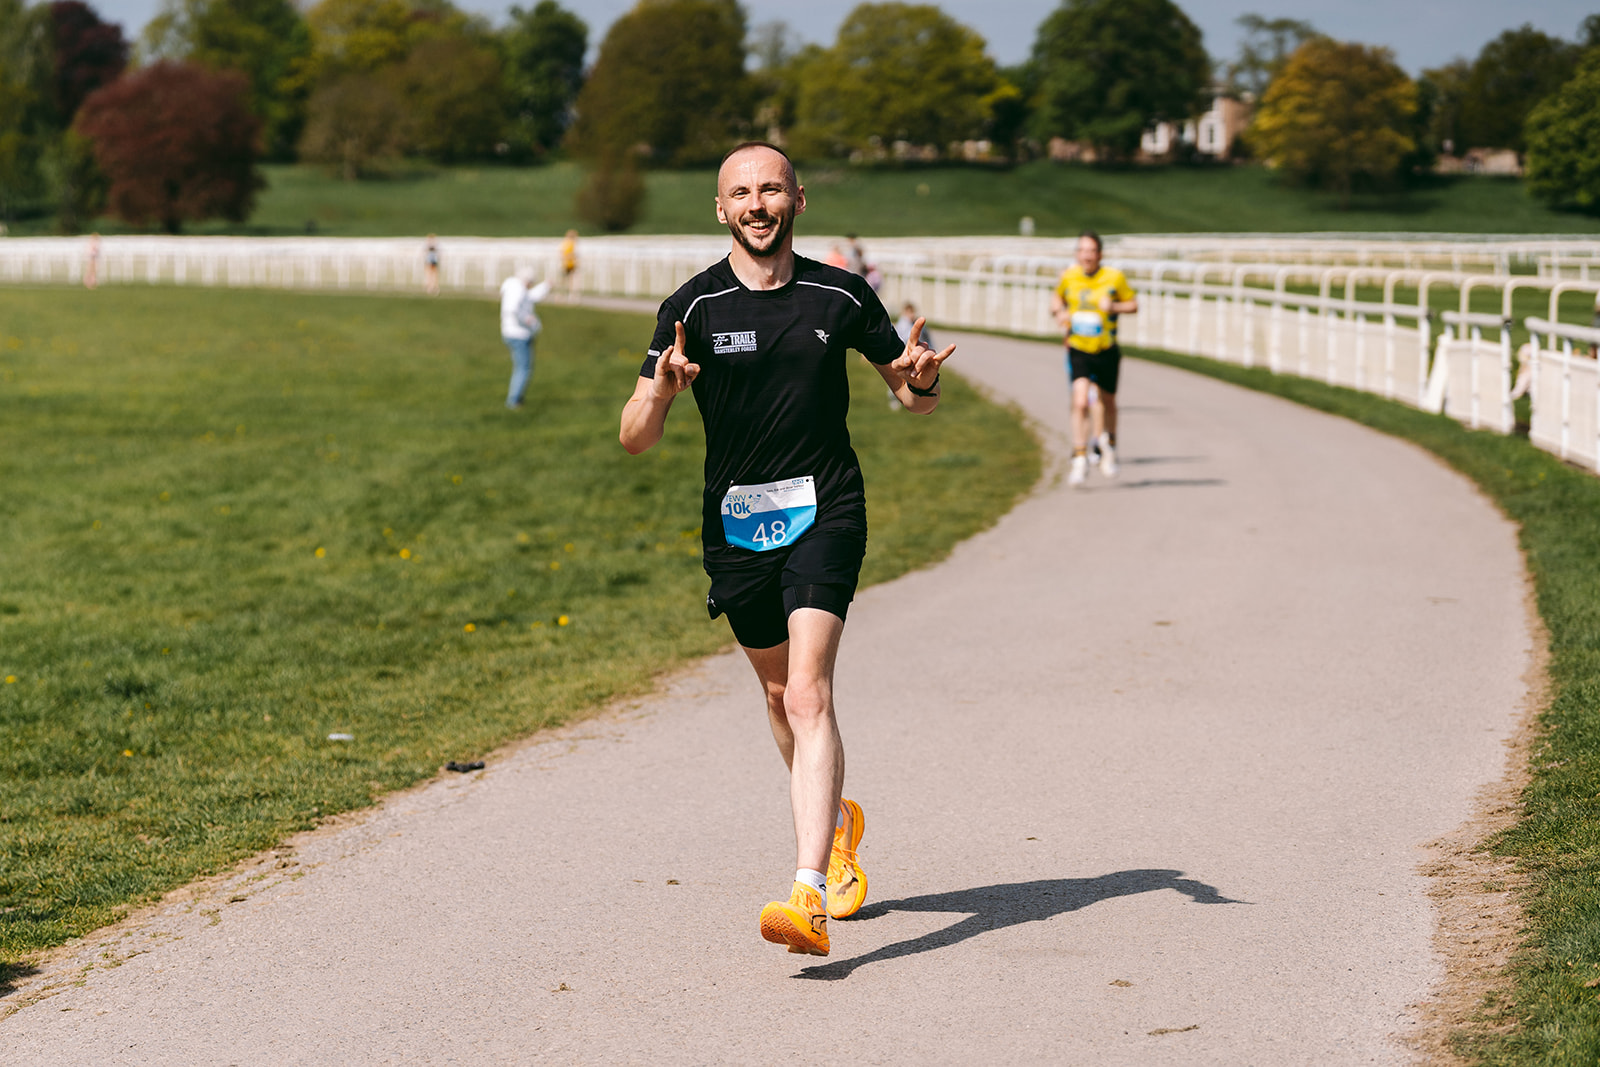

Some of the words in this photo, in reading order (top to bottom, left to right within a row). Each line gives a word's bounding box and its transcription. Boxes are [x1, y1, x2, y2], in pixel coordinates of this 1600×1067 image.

[730, 333, 757, 345] TRAILS
[726, 494, 747, 502] TEWV
[725, 502, 752, 515] 10k
[752, 520, 786, 547] 48
